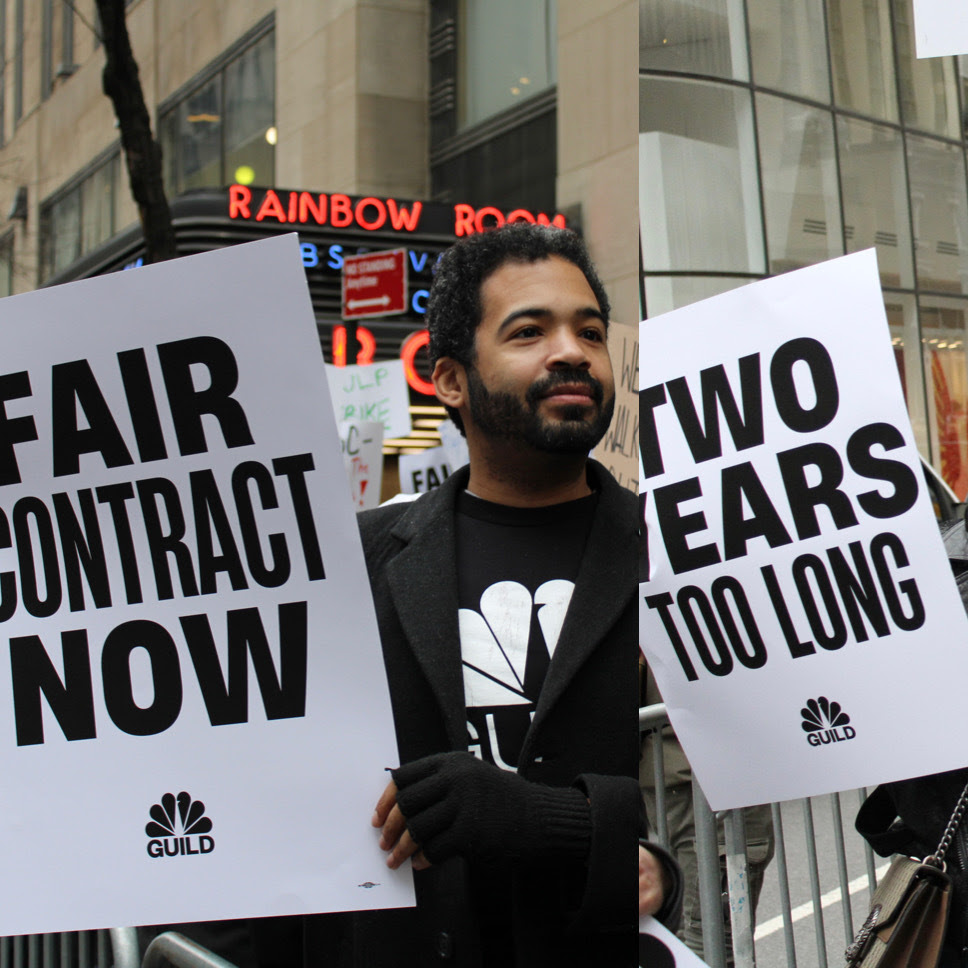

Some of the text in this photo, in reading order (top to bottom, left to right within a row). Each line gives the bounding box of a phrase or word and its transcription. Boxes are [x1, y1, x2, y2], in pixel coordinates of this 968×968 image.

[229, 184, 422, 231] RAINBOW
[346, 276, 378, 290] Anytime
[359, 257, 395, 273] STANDING
[0, 336, 255, 487] FAIR
[639, 337, 840, 480] TWO
[411, 462, 452, 493] FAI
[645, 532, 926, 682] TOO LONG
[9, 601, 308, 746] NOW
[807, 725, 856, 747] GUILD
[146, 835, 216, 858] GUILD
